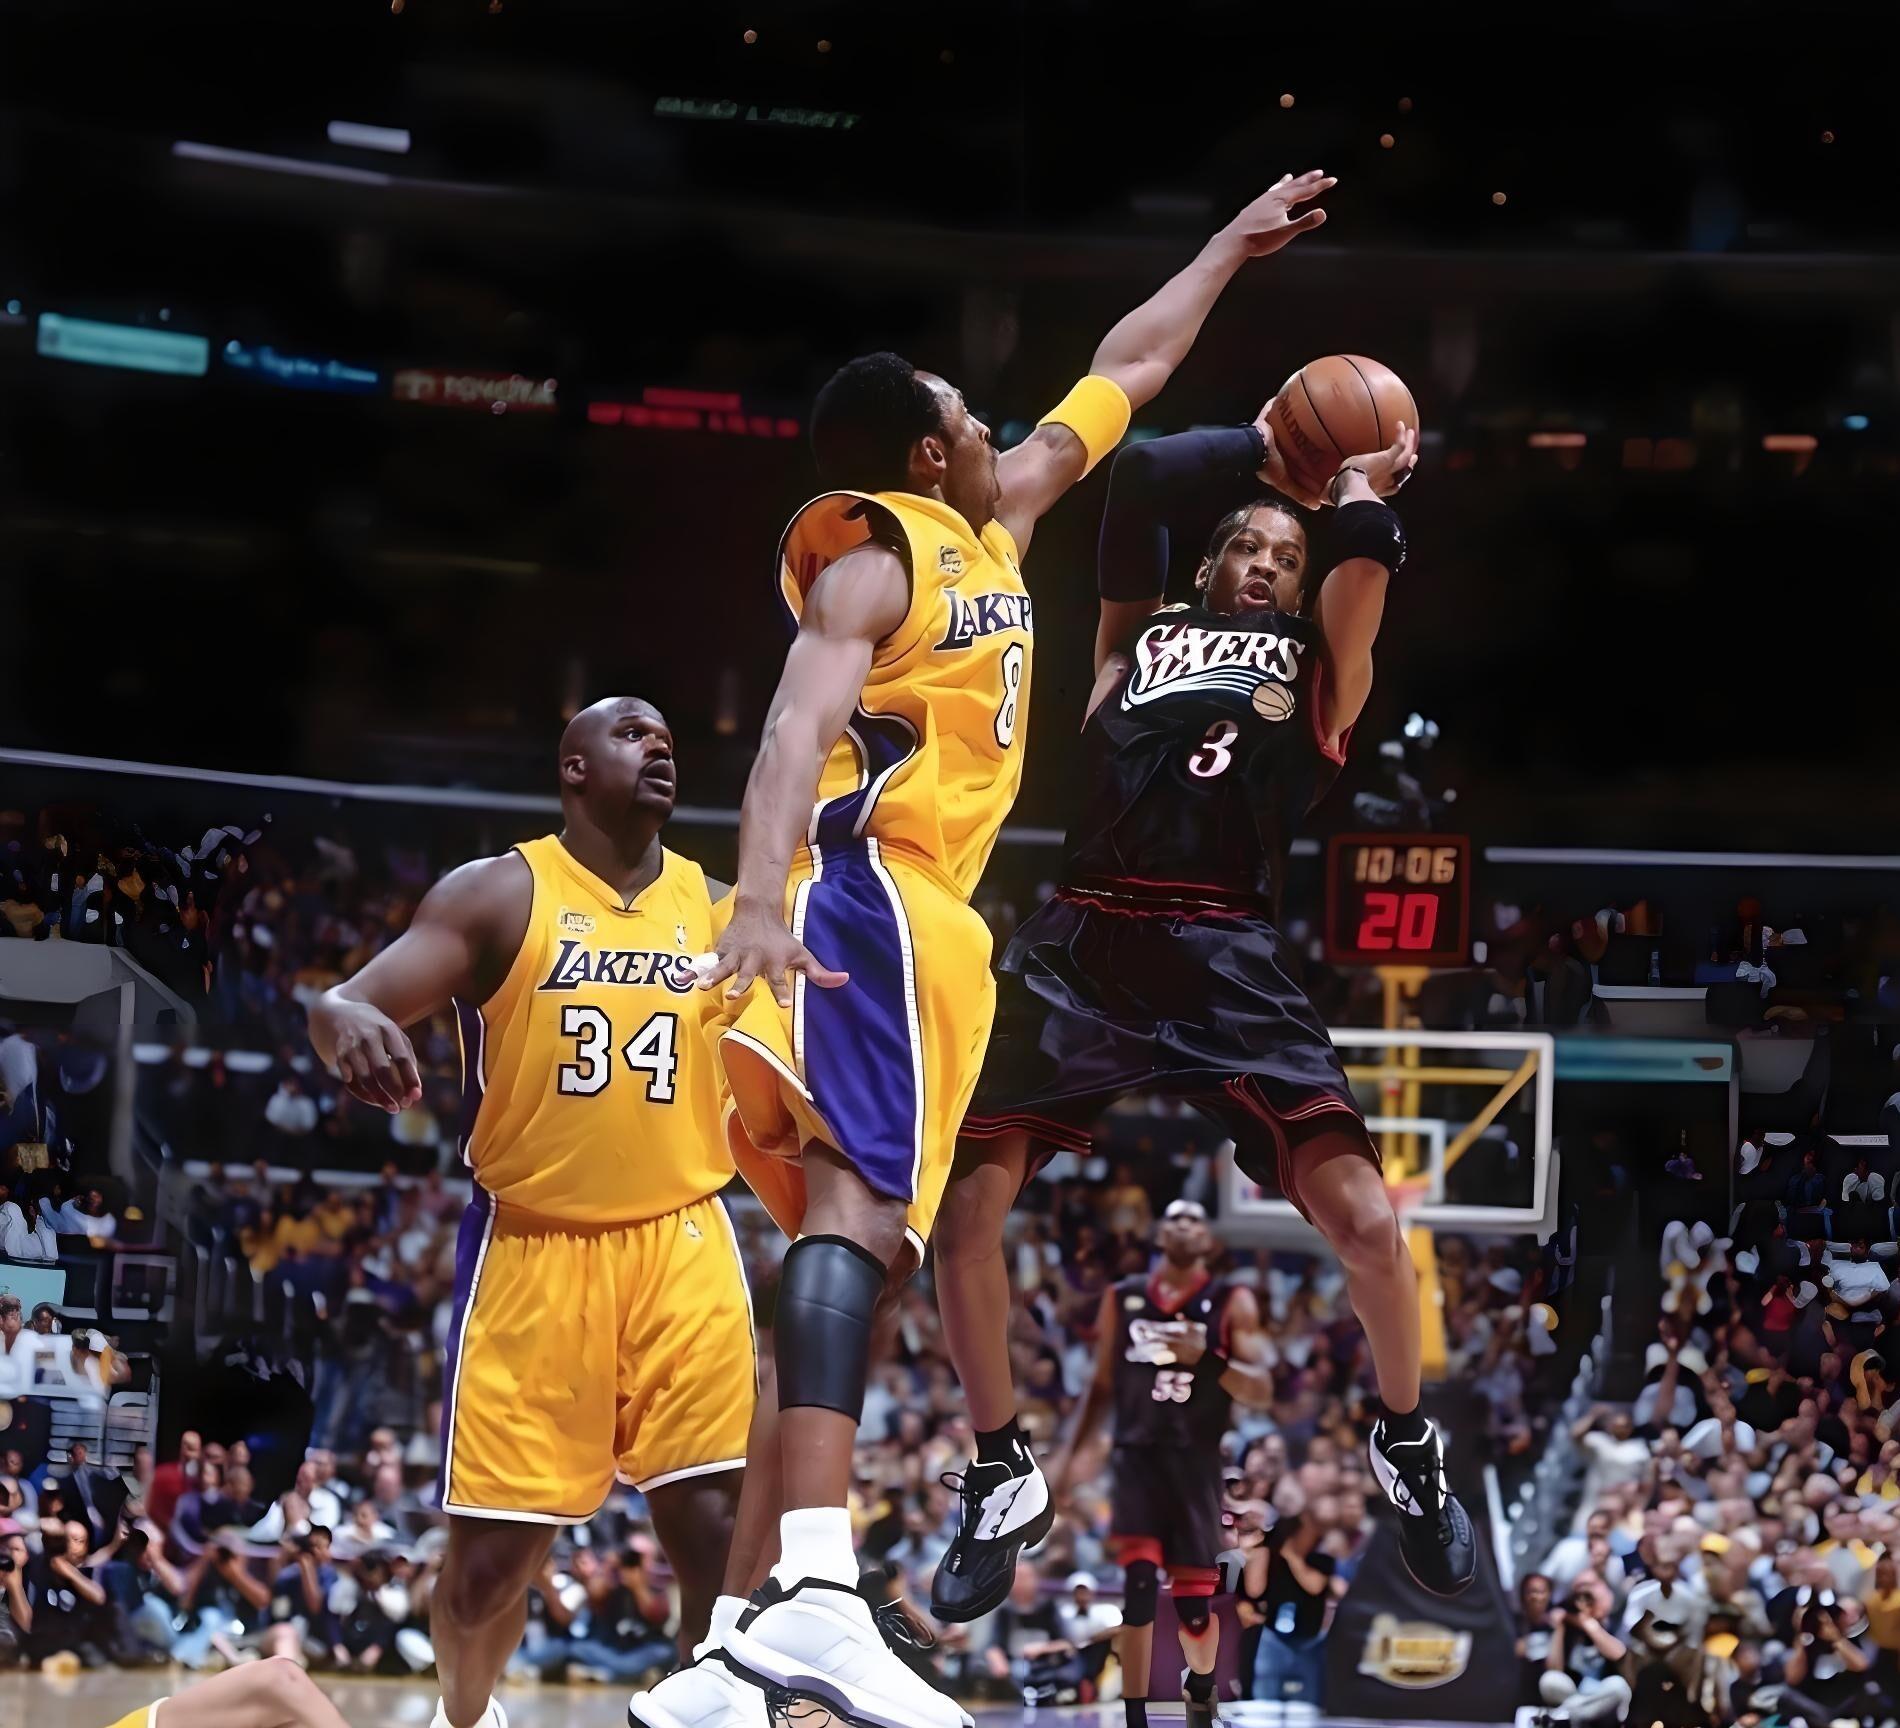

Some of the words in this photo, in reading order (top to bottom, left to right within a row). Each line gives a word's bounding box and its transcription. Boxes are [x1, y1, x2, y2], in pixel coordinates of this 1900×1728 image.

[994, 641, 1024, 750] 8
[1188, 719, 1239, 778] 3
[1354, 846, 1458, 884] 10:06
[1357, 892, 1439, 950] 20
[536, 939, 695, 994] LAKERS
[557, 1004, 679, 1105] 34
